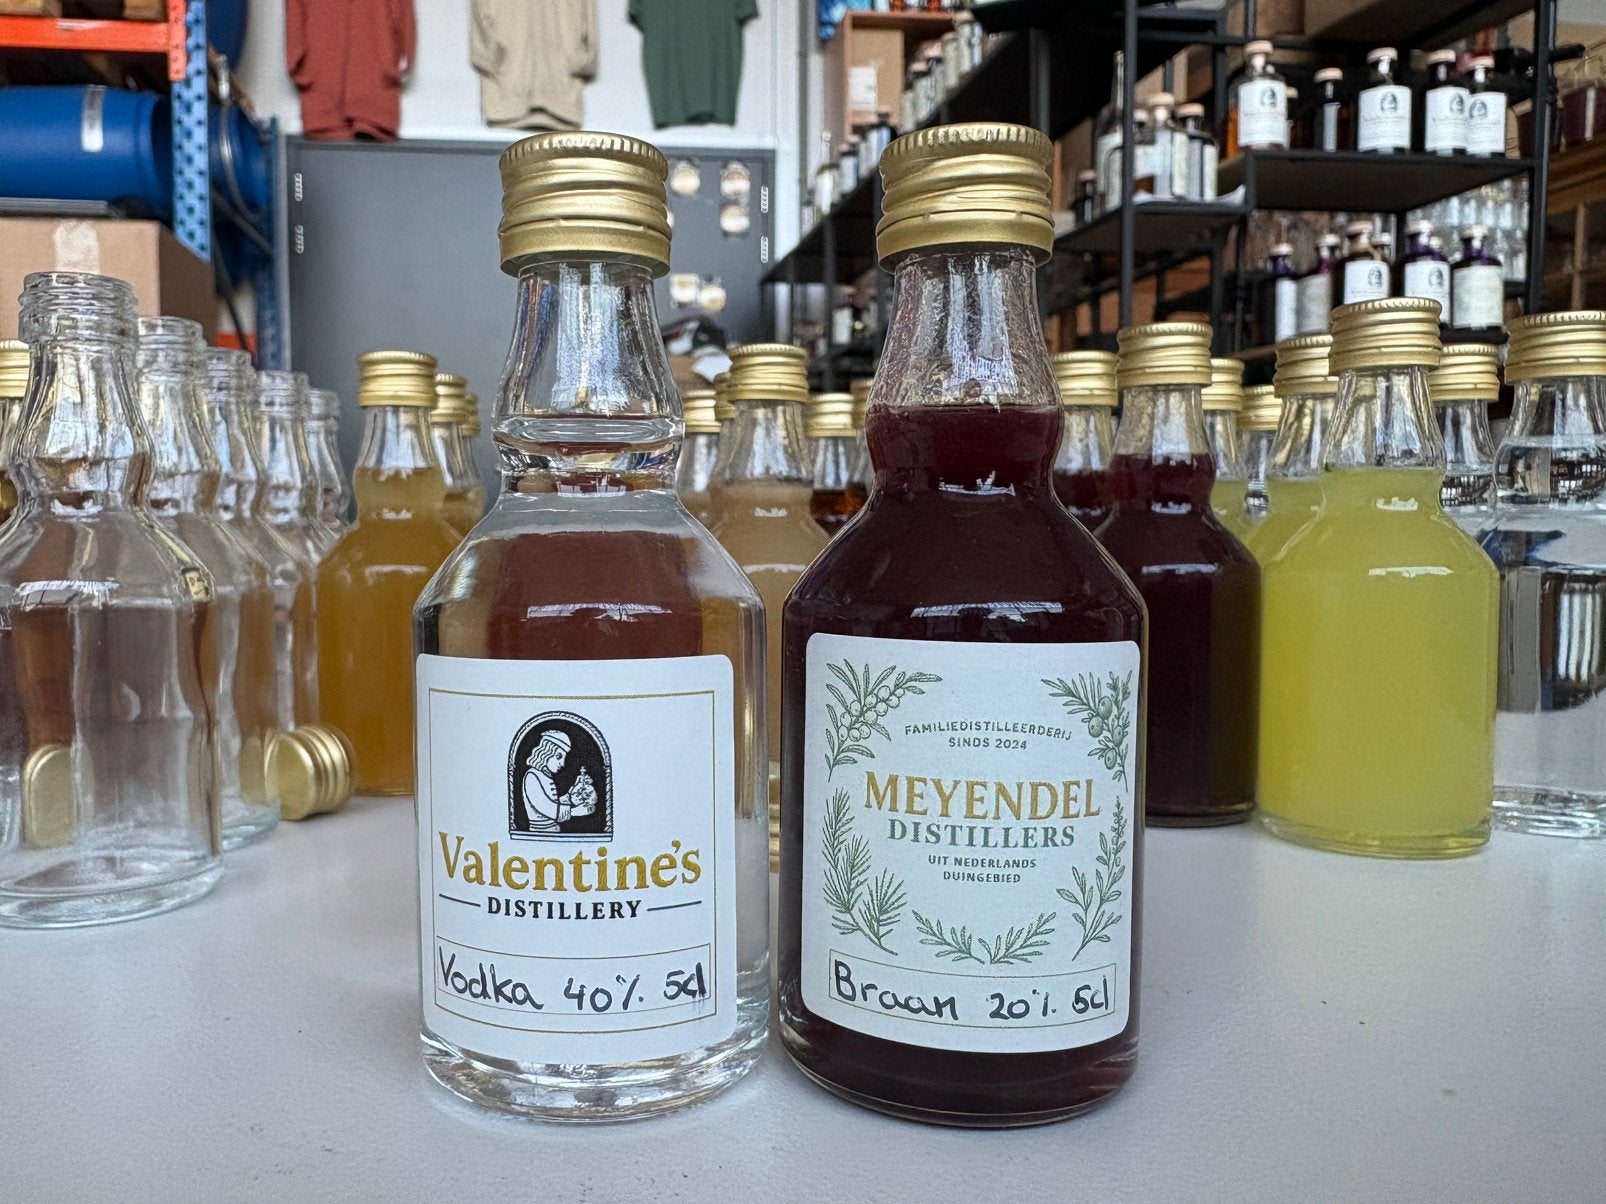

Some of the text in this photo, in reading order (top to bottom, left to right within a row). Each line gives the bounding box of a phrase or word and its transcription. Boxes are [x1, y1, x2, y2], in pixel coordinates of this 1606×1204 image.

[904, 721, 1072, 741] FAMILIEDISTILLEERDERIJ
[948, 737, 1027, 750] SINDS 2024
[863, 771, 1101, 821] MEYENDEL
[888, 818, 1075, 848] DISTILLERS
[438, 831, 702, 892] Valentine's
[928, 855, 1037, 869] UIT NEDERLANDS
[943, 871, 1021, 883] DUINGEBIED
[487, 896, 642, 920] DISTILLERY
[439, 946, 544, 1010] Vodka
